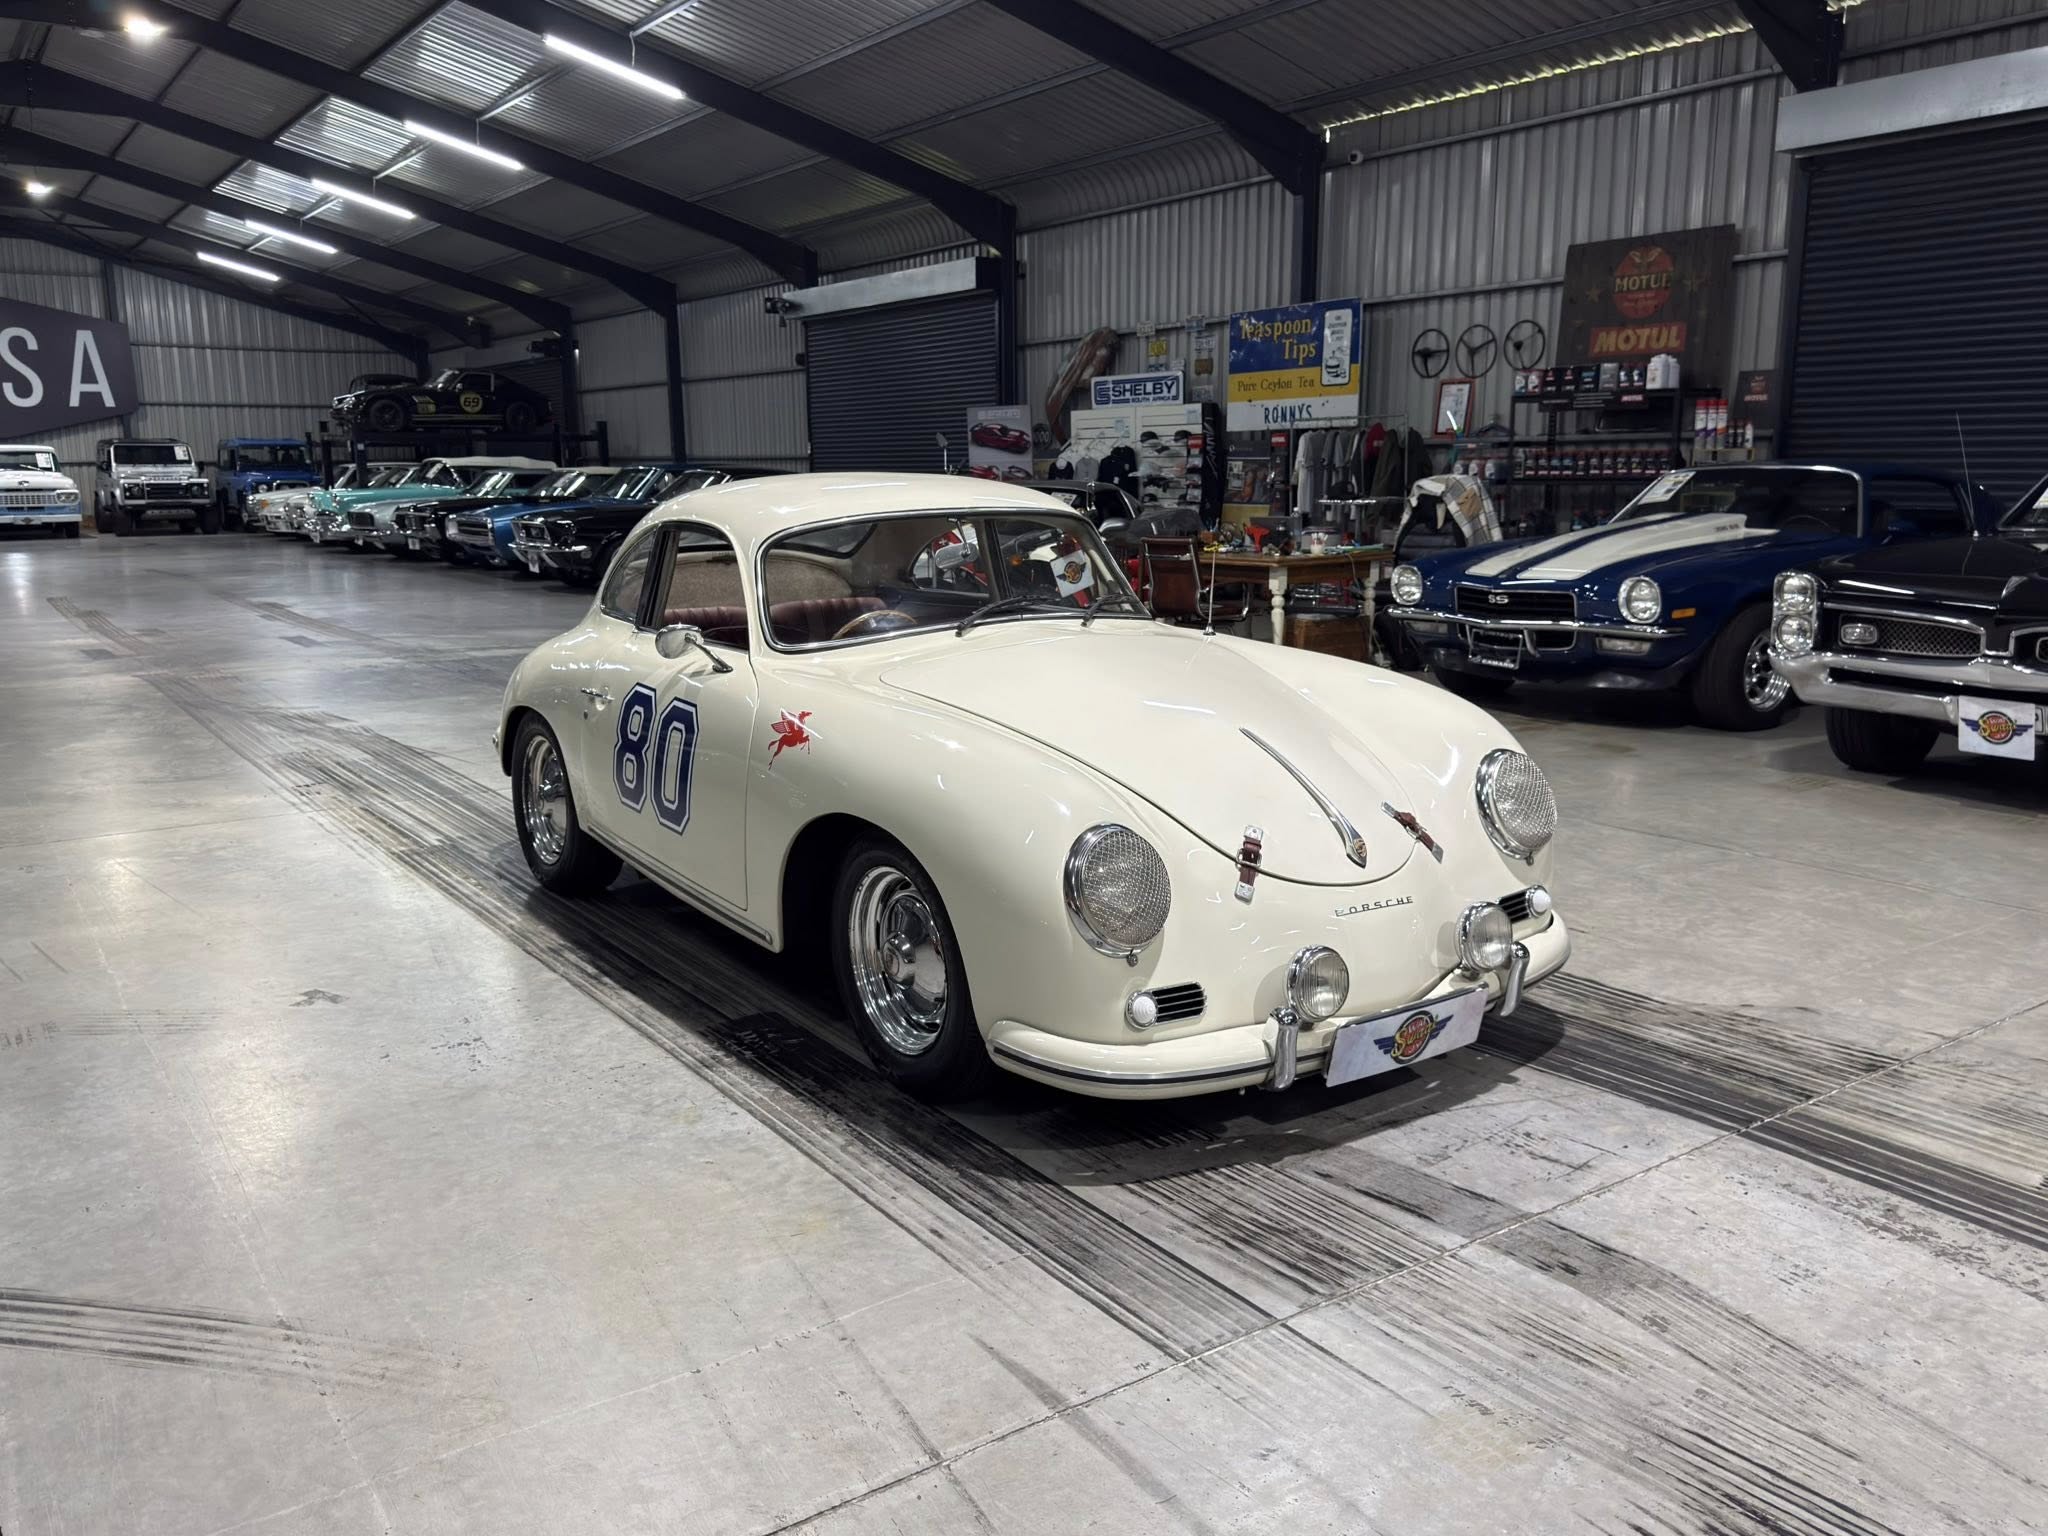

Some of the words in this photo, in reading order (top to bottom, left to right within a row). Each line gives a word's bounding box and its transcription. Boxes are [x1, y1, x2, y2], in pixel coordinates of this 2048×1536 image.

[1615, 272, 1671, 293] MOTUL
[1240, 317, 1313, 343] Teaspoon
[1594, 326, 1681, 353] MOTUL
[1282, 338, 1317, 365] Tips
[1112, 381, 1175, 398] SHELBY
[1238, 379, 1257, 392] Pure
[1260, 377, 1292, 392] Ceylon
[1297, 375, 1315, 388] Tea
[463, 396, 480, 408] 69
[1264, 404, 1313, 424] RONNYS
[1487, 594, 1509, 604] SS
[612, 682, 700, 836] 80
[1335, 896, 1413, 917] PORSCHE
